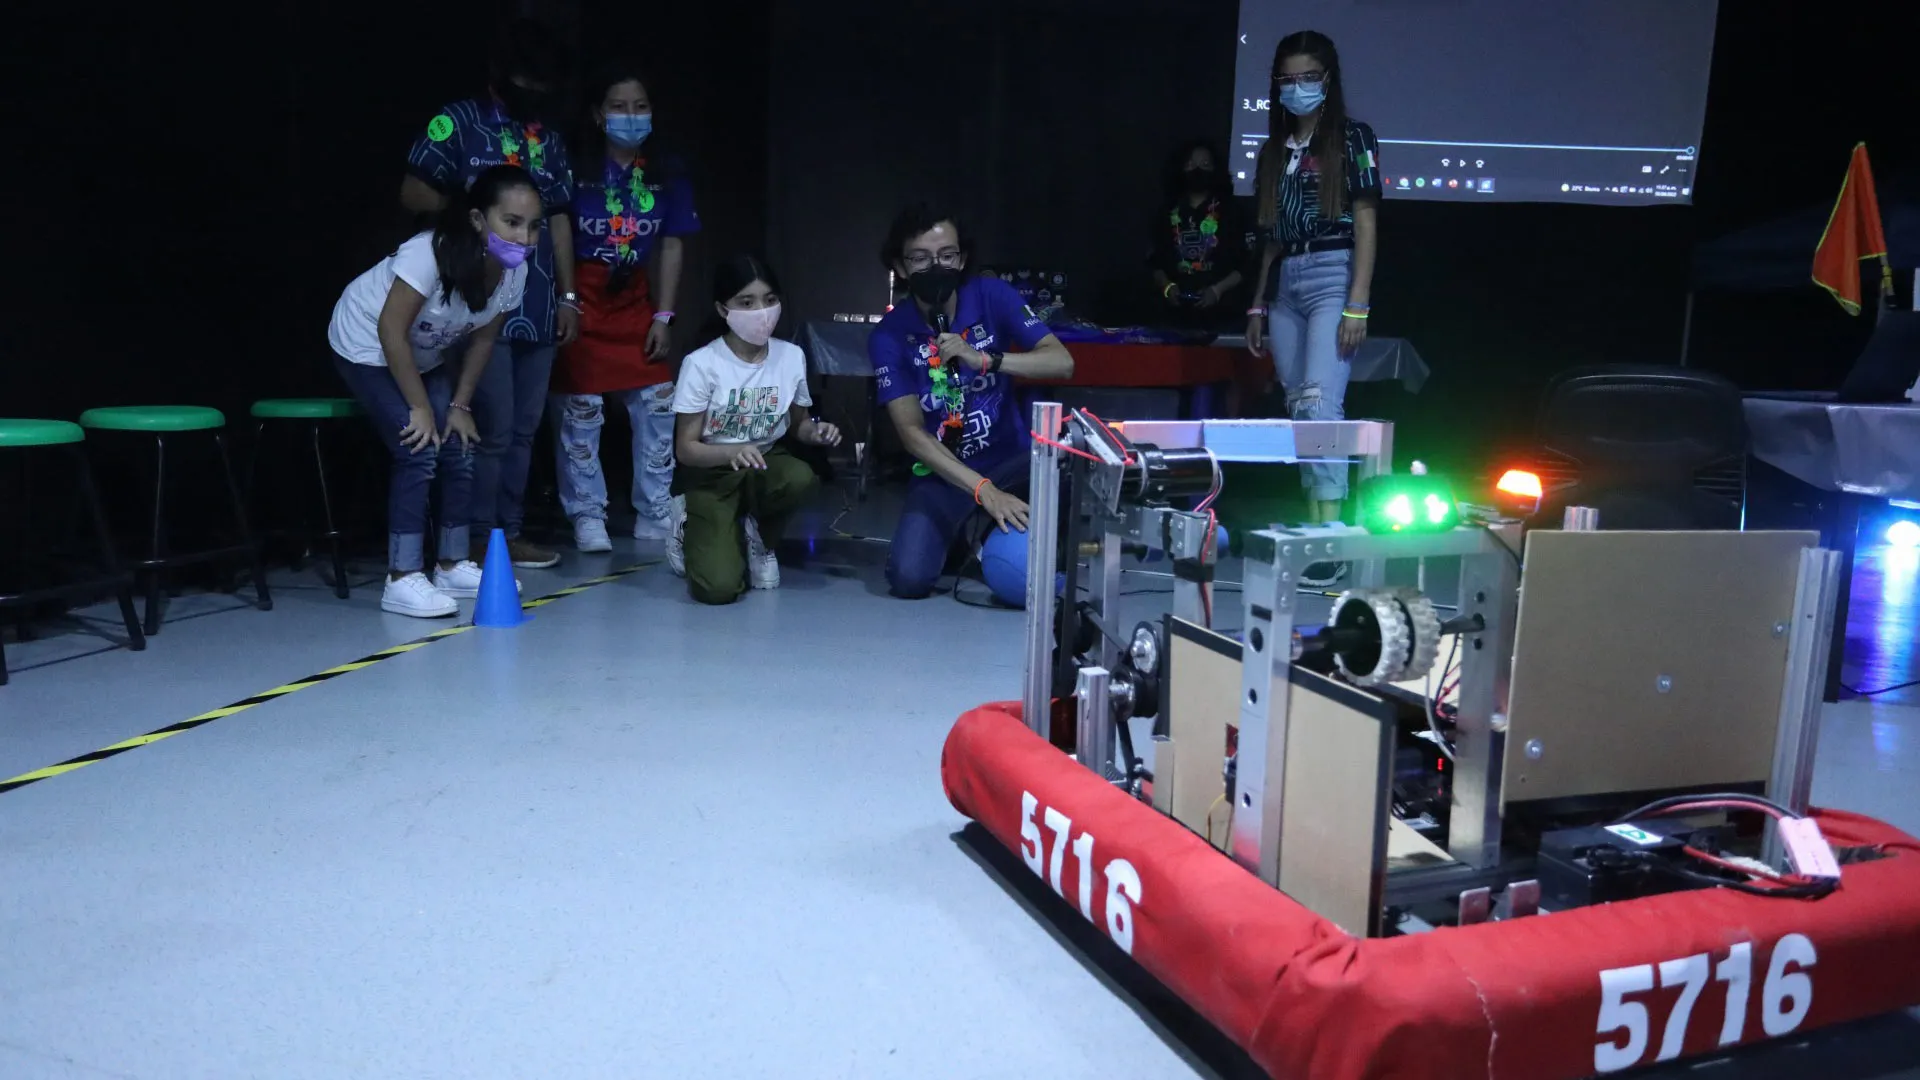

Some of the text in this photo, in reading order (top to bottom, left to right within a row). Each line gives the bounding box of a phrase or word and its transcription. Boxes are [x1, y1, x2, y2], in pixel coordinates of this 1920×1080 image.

[709, 410, 782, 441] NATUR
[726, 386, 779, 415] LOVE
[1021, 790, 1142, 956] 5716
[1594, 933, 1817, 1073] 5716
